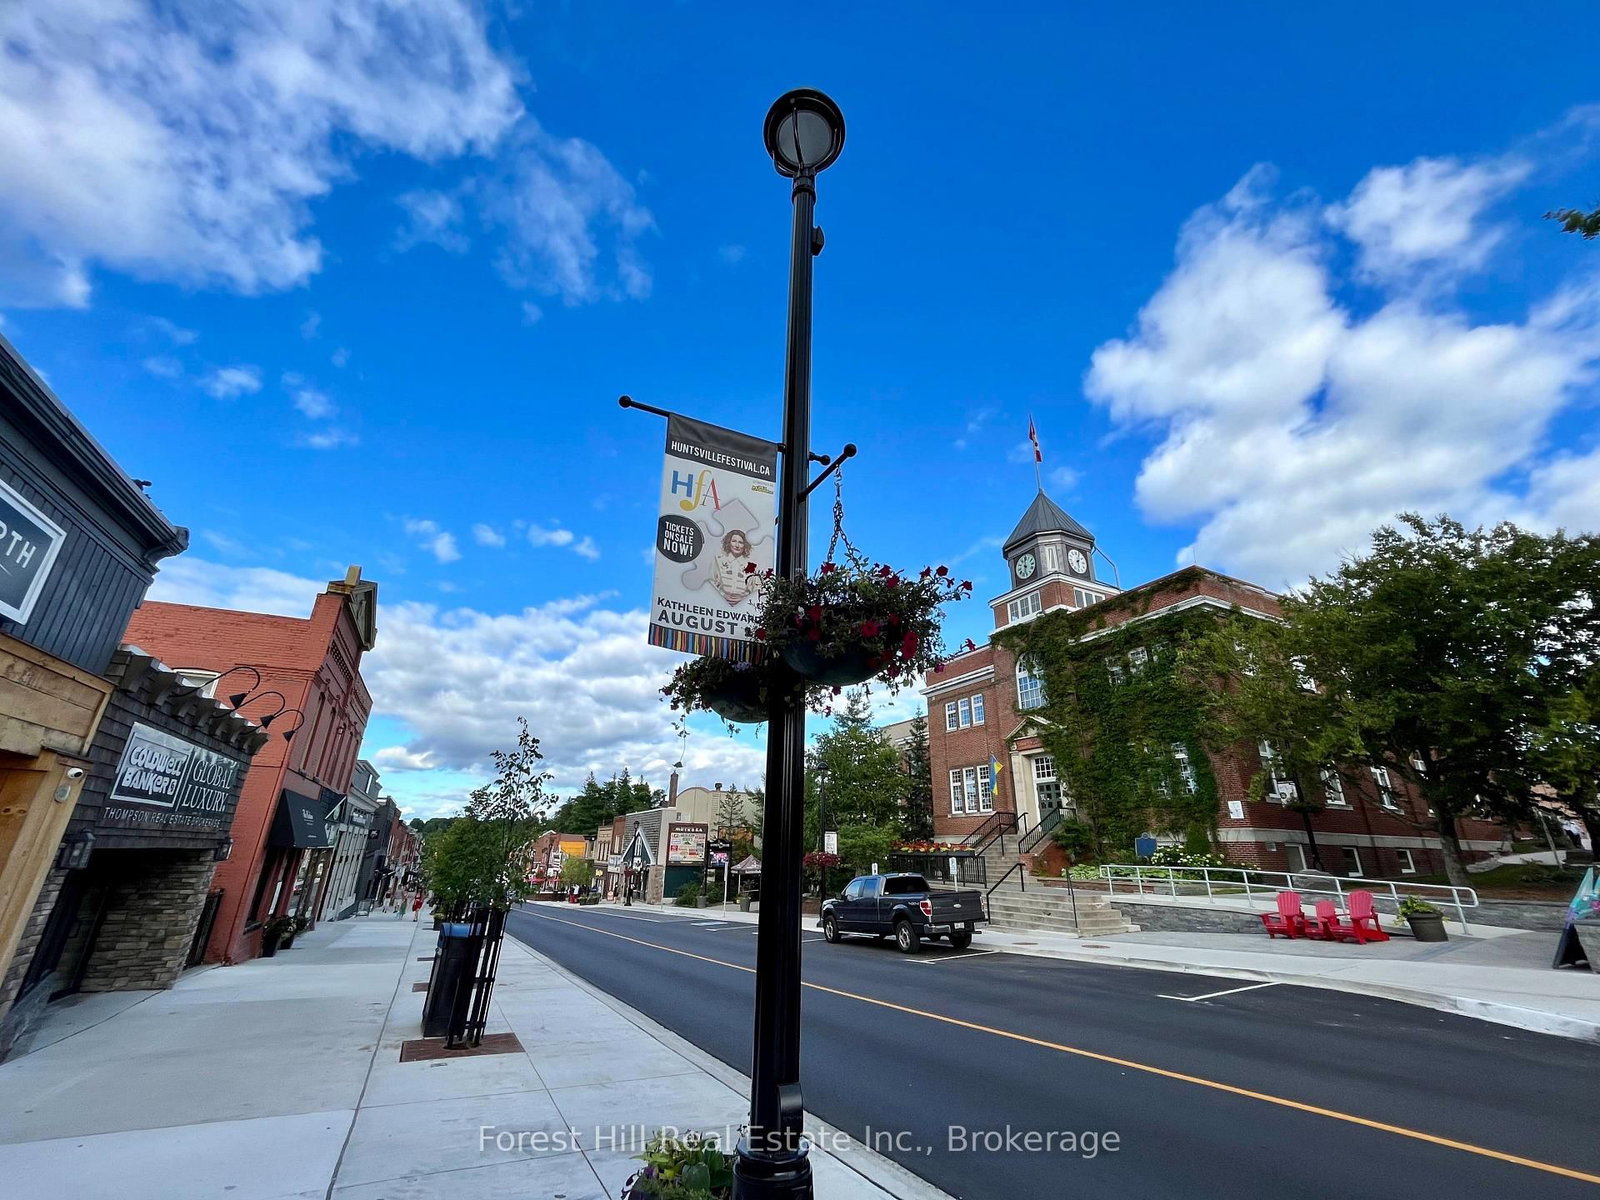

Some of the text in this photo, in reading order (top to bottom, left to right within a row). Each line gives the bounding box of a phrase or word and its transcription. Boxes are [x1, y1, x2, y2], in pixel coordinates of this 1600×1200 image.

[671, 440, 770, 476] HUNTSVILLEFESTIVAL.CA
[664, 530, 694, 545] ON SALE
[665, 521, 694, 536] TICKETS
[663, 538, 694, 557] NOW!
[657, 596, 763, 625] KATHLEEN EDWARD
[657, 609, 738, 635] AUGUST
[192, 759, 234, 790] GLOBAL
[103, 807, 149, 823] THOMPSON
[151, 811, 169, 824] REAL
[168, 814, 193, 826] ESTATE
